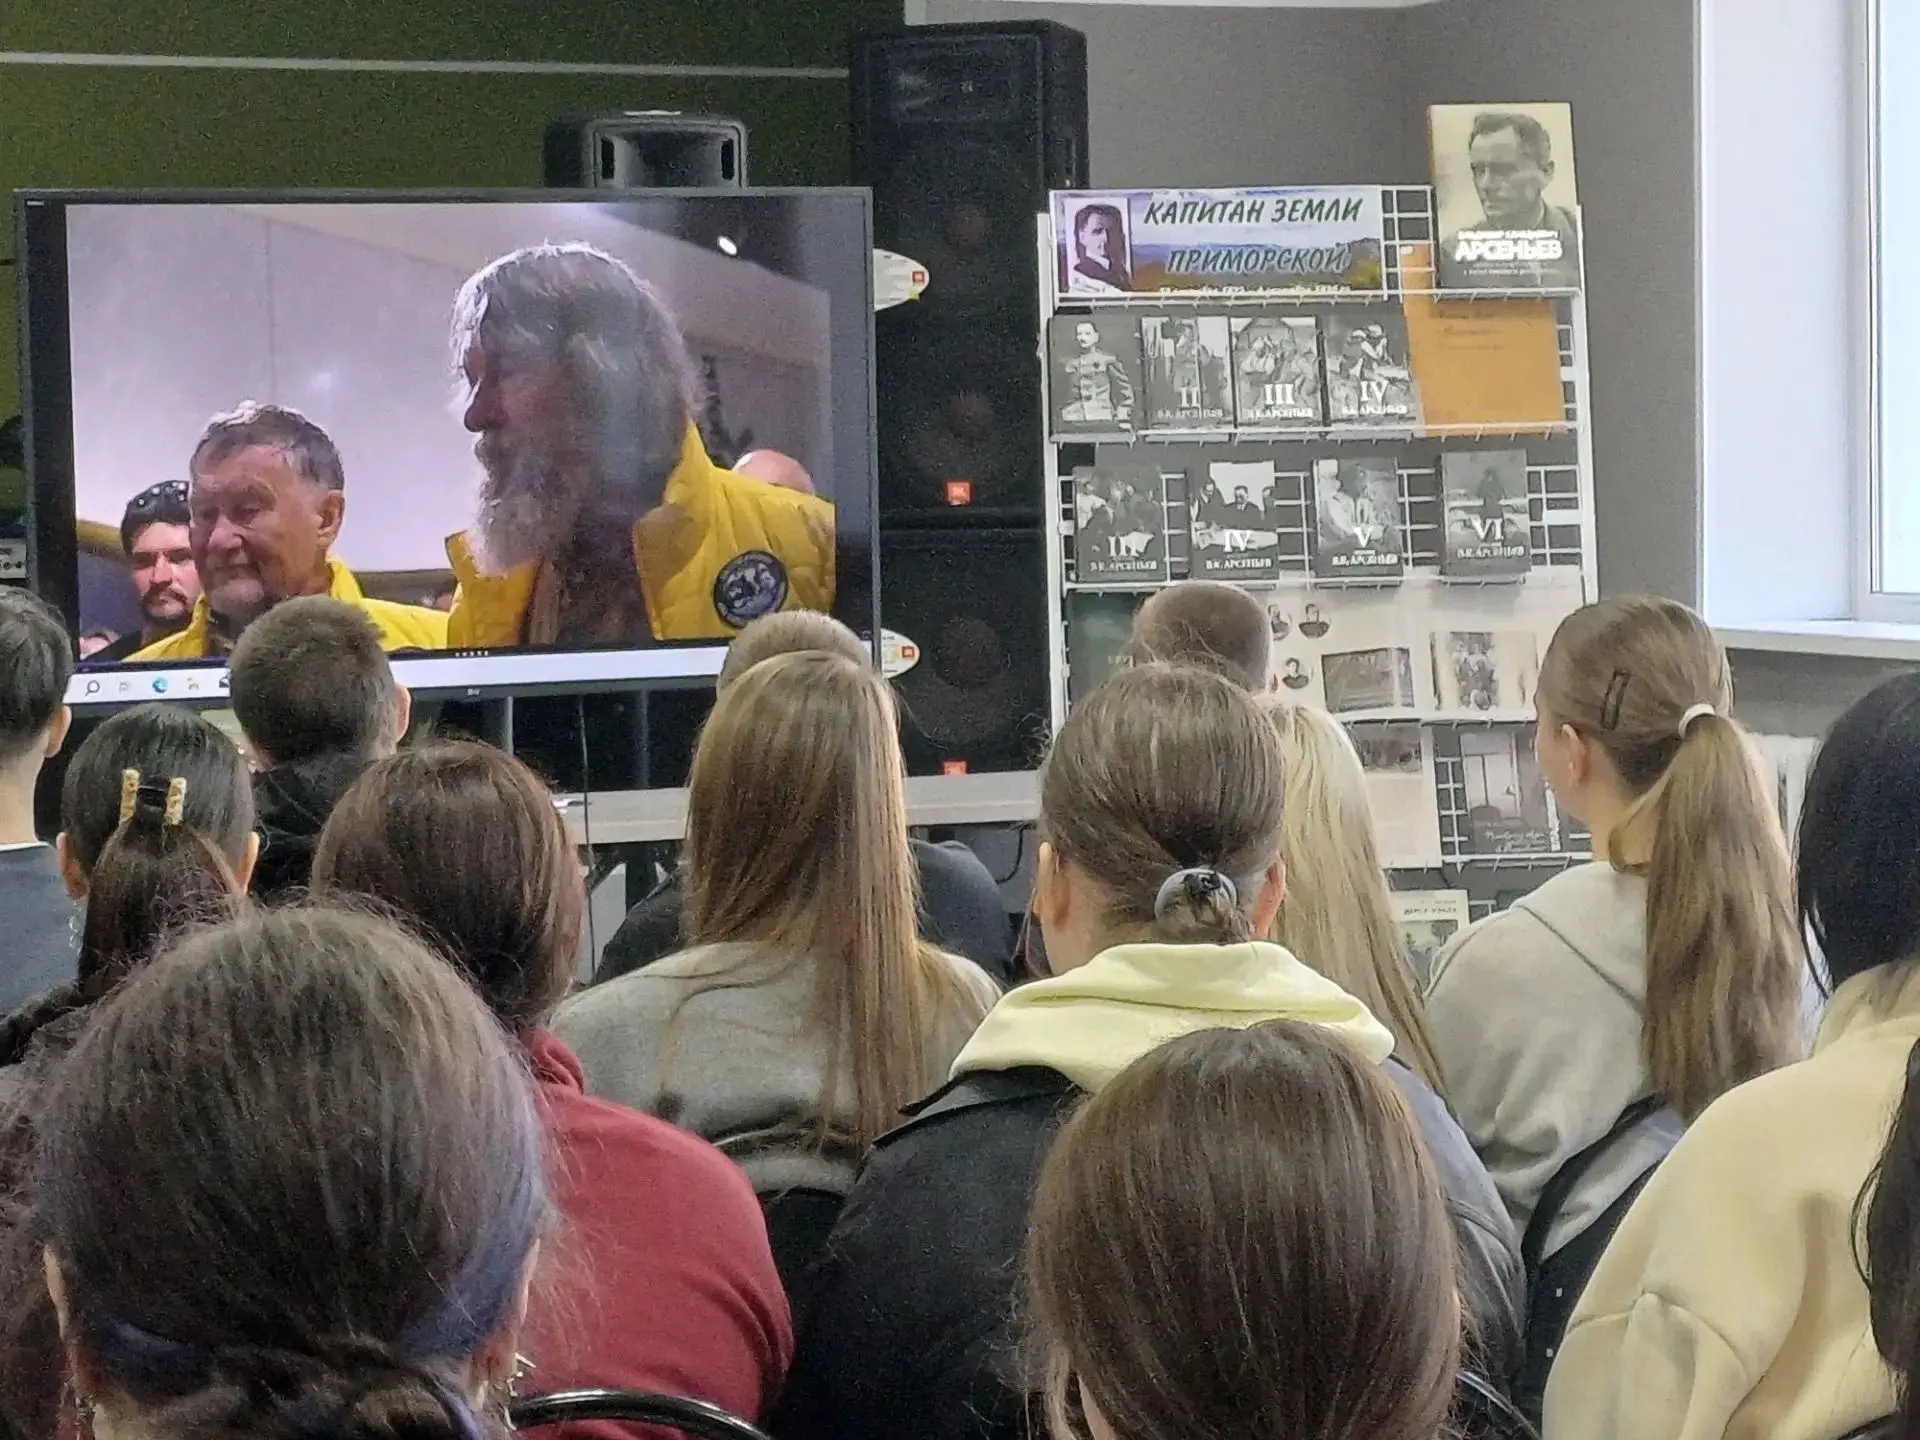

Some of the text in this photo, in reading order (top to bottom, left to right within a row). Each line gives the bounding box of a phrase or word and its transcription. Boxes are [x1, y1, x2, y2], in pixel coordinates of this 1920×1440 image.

[1143, 198, 1364, 225] КАПИТАН ЗЕМЛИ
[1167, 246, 1349, 274] ПРИМОРСКОЙ
[1455, 239, 1563, 261] АРСЕНЬЕВ
[1264, 383, 1296, 405] III
[1360, 380, 1389, 402] IV
[1353, 525, 1375, 547] V
[1470, 515, 1504, 541] VI
[1223, 531, 1251, 552] IV
